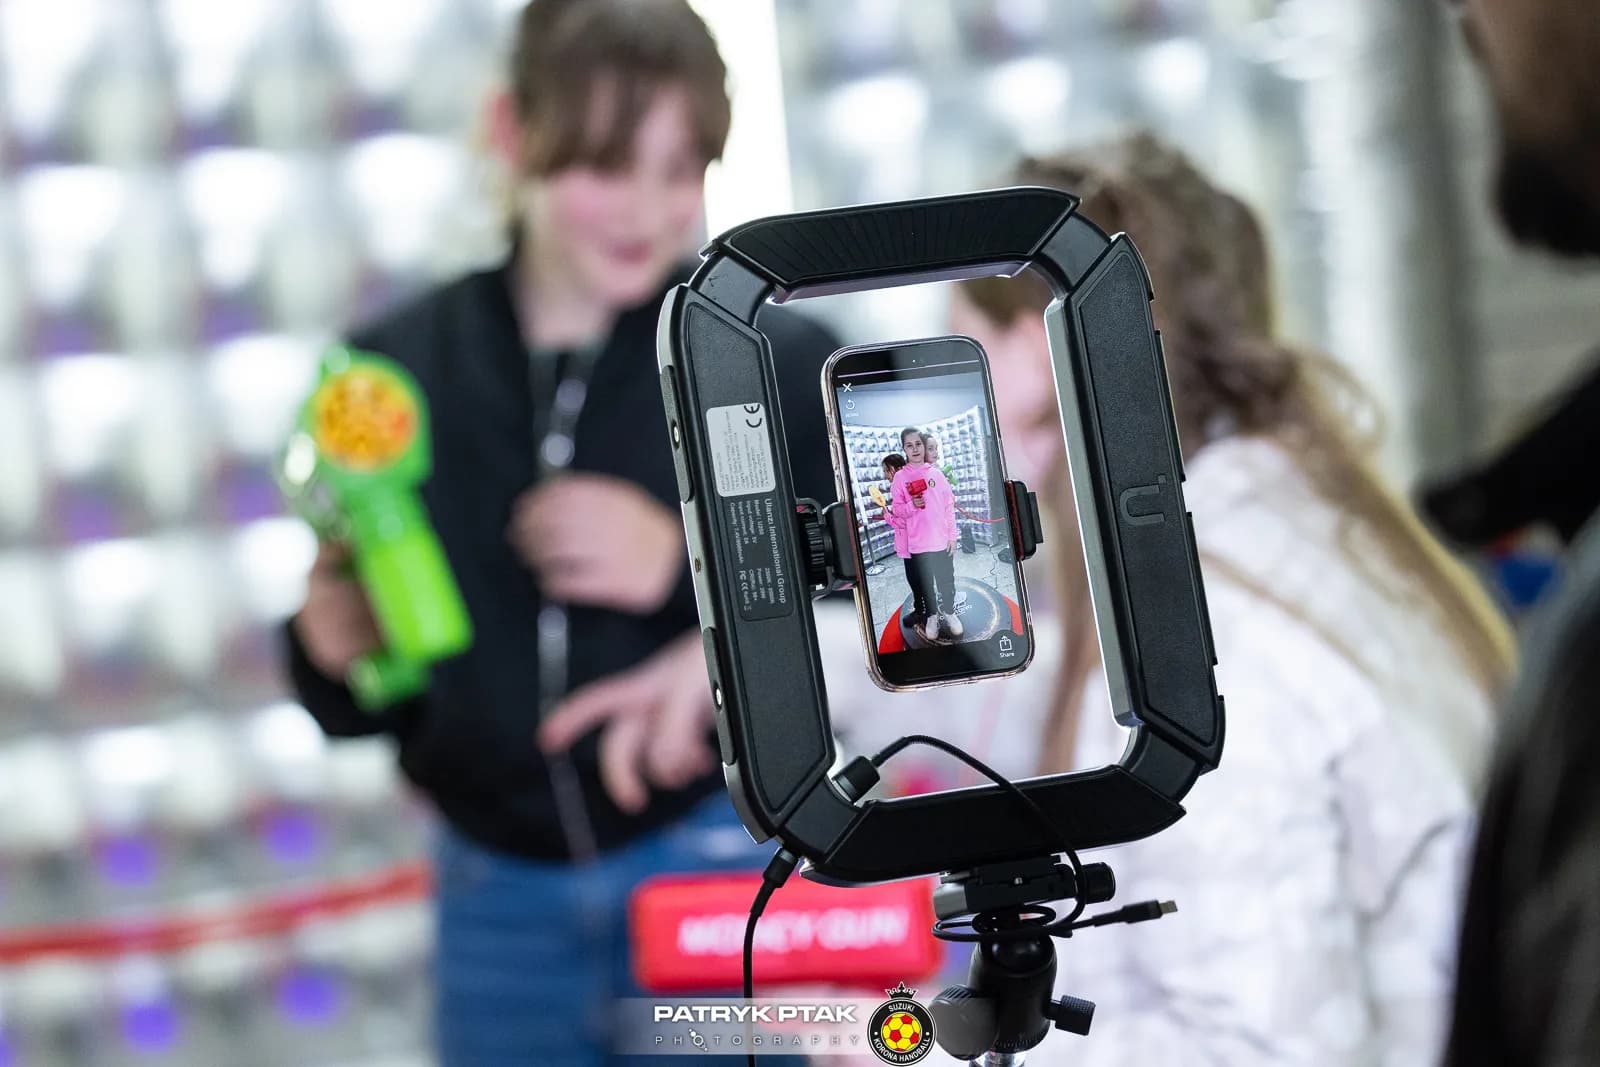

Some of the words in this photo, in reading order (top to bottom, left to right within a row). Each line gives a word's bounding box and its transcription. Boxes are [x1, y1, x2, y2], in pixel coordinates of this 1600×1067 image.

[764, 498, 774, 525] Ulanzi
[768, 526, 783, 576] International
[777, 578, 787, 604] Group
